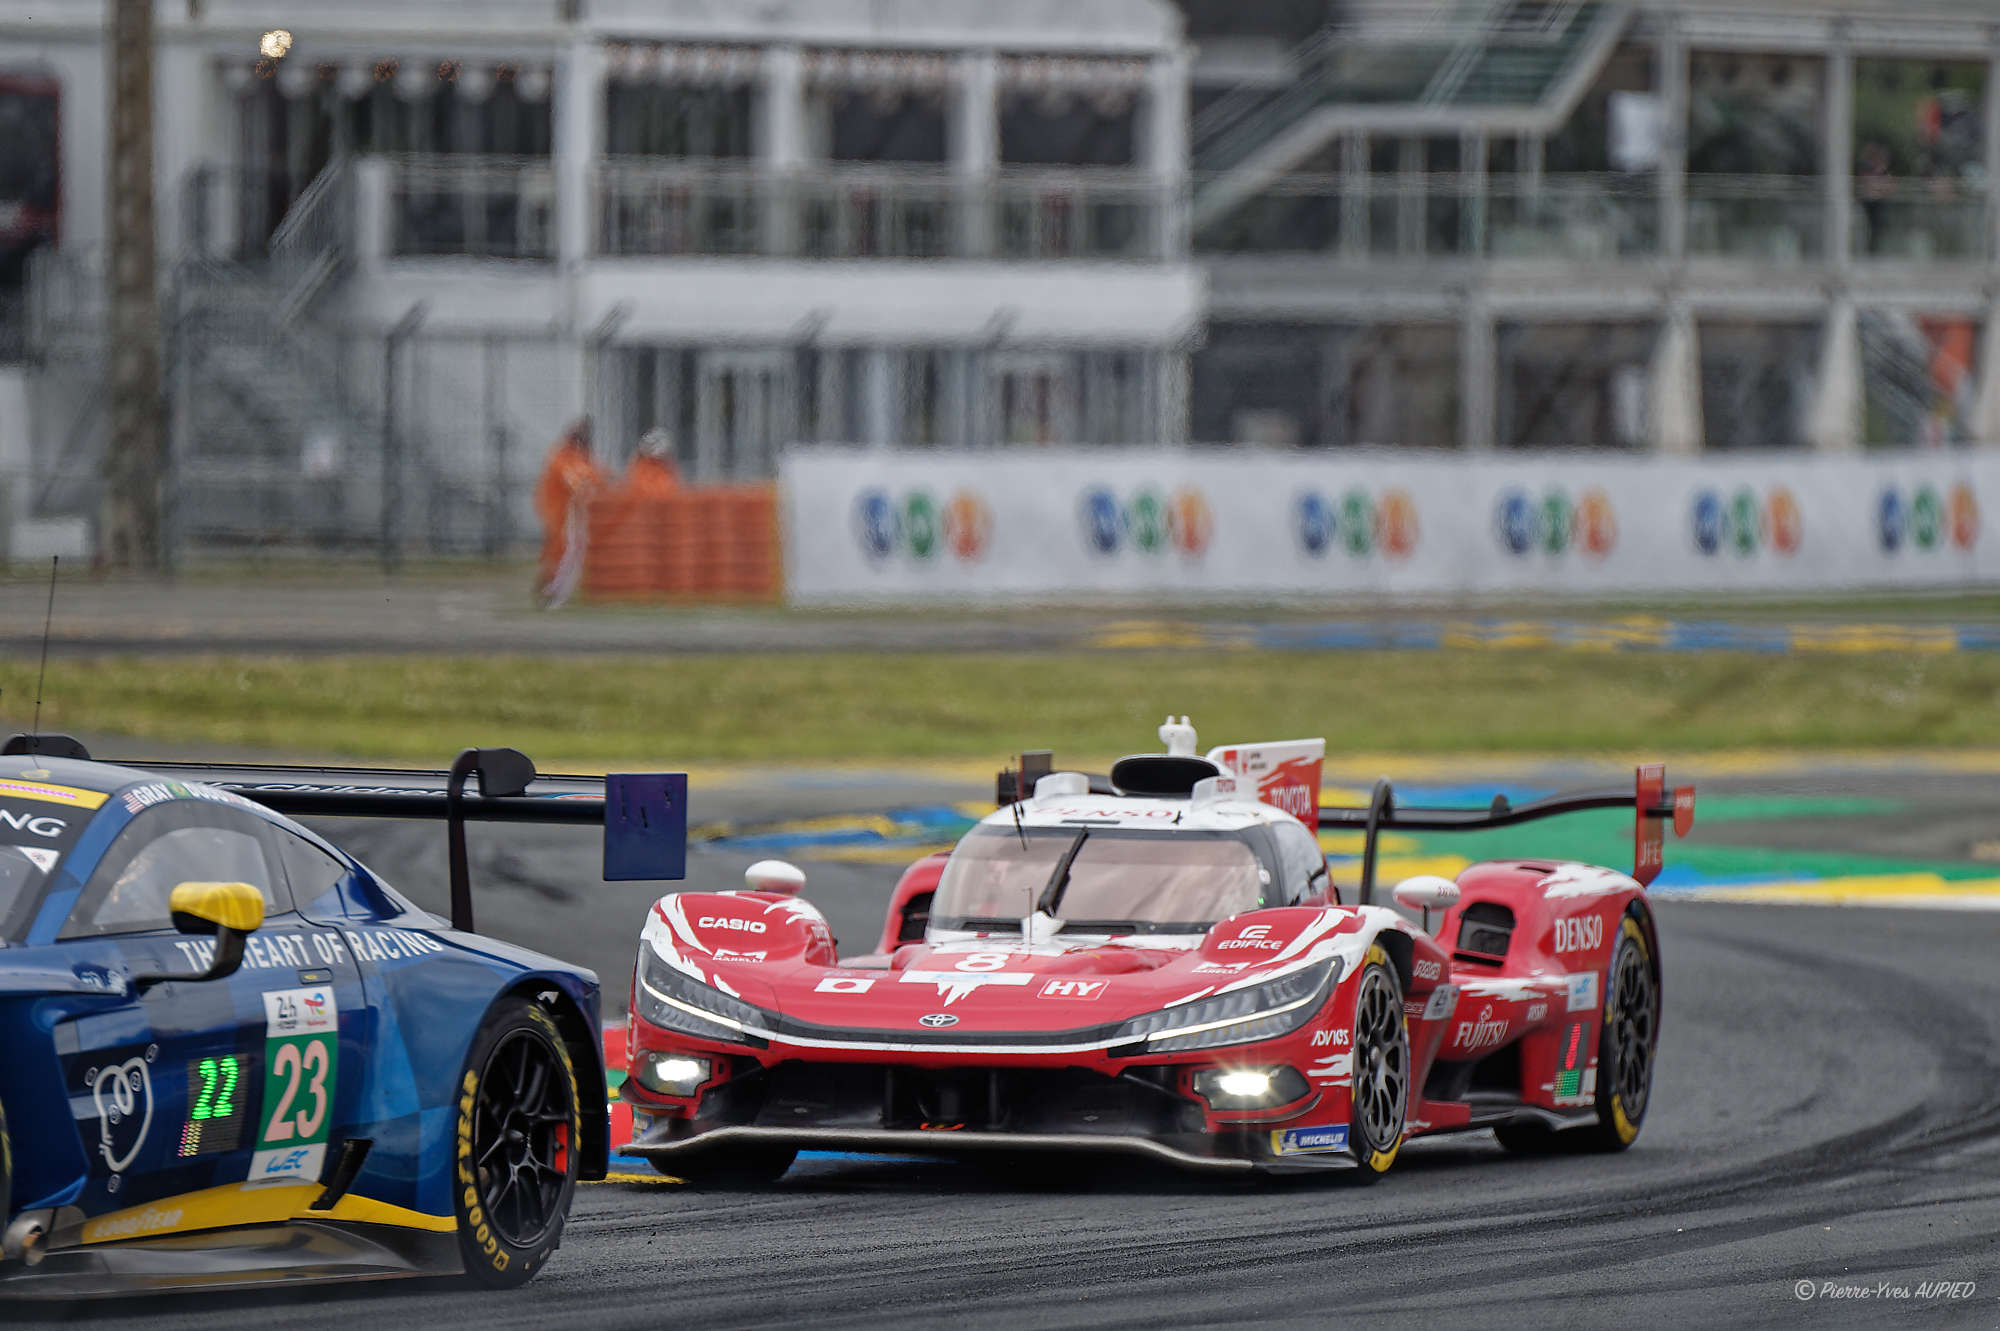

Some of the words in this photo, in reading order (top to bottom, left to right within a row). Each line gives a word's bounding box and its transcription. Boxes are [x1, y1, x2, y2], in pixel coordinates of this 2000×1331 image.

[131, 782, 176, 808] GRAY
[1270, 784, 1312, 816] TOYOTA
[698, 916, 767, 934] CASIO
[1555, 914, 1603, 953] DENSO
[174, 939, 217, 973] TH
[311, 932, 345, 965] OF
[344, 930, 445, 962] RACING
[1217, 939, 1284, 950] EDIFICE
[954, 952, 1010, 973] 8
[1044, 980, 1104, 996] HY
[1454, 1018, 1509, 1053] FUJITSU
[263, 1040, 329, 1142] 23
[1300, 1132, 1345, 1147] MICHELIN
